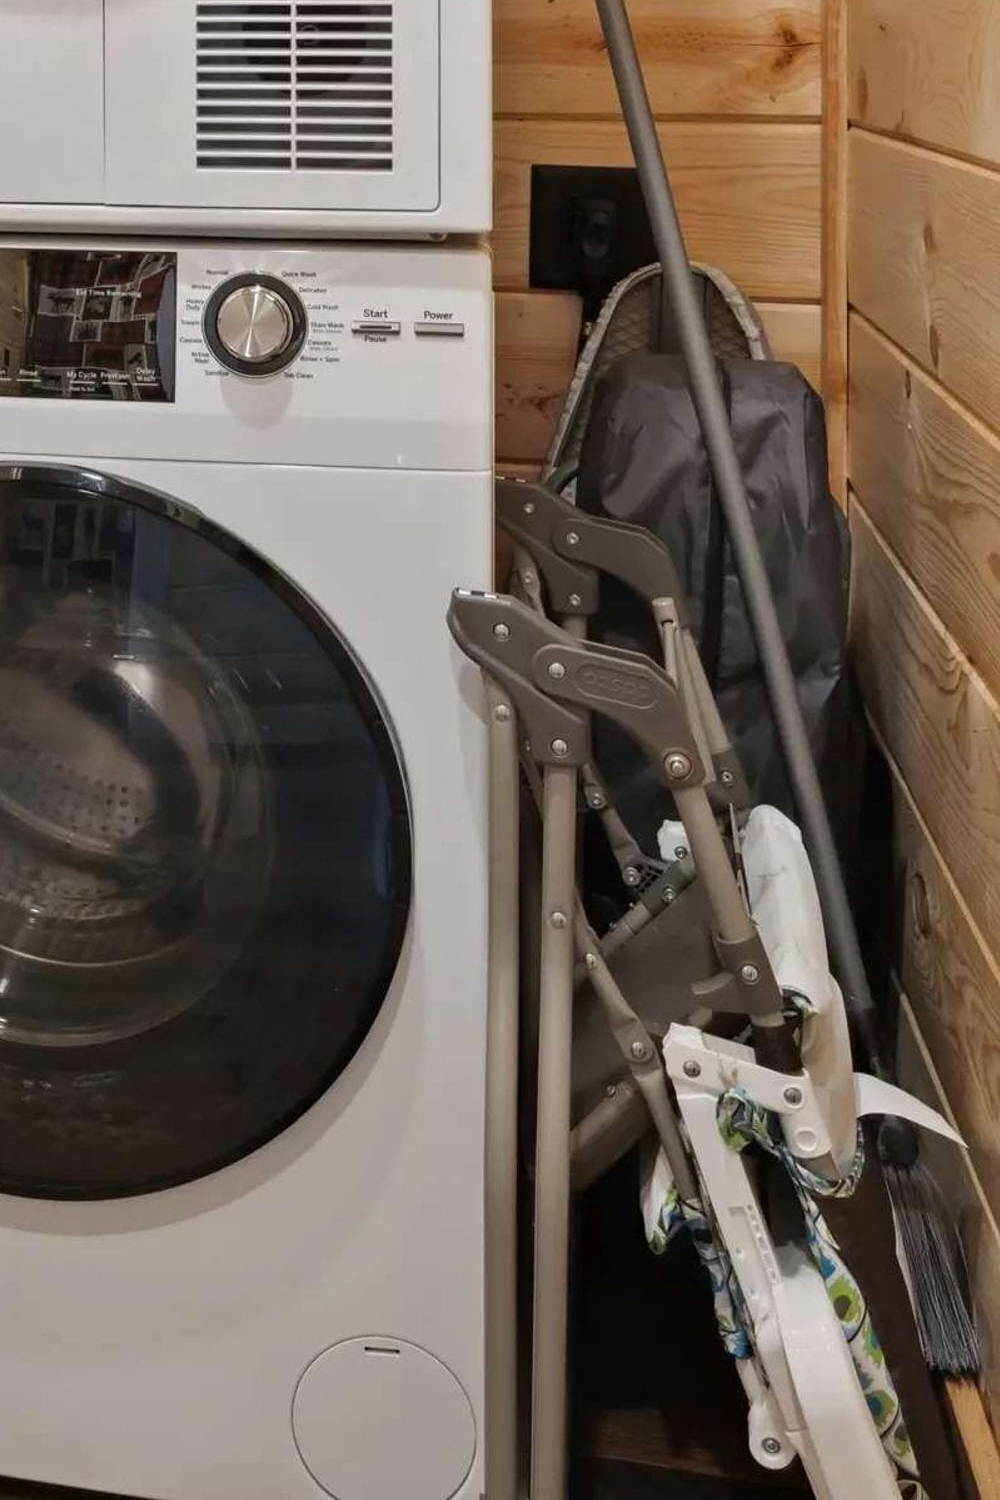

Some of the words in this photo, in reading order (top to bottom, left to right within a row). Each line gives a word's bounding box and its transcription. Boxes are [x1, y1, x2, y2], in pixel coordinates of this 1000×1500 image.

[363, 308, 388, 318] Start
[424, 310, 453, 319] Power
[78, 371, 97, 380] Cycle
